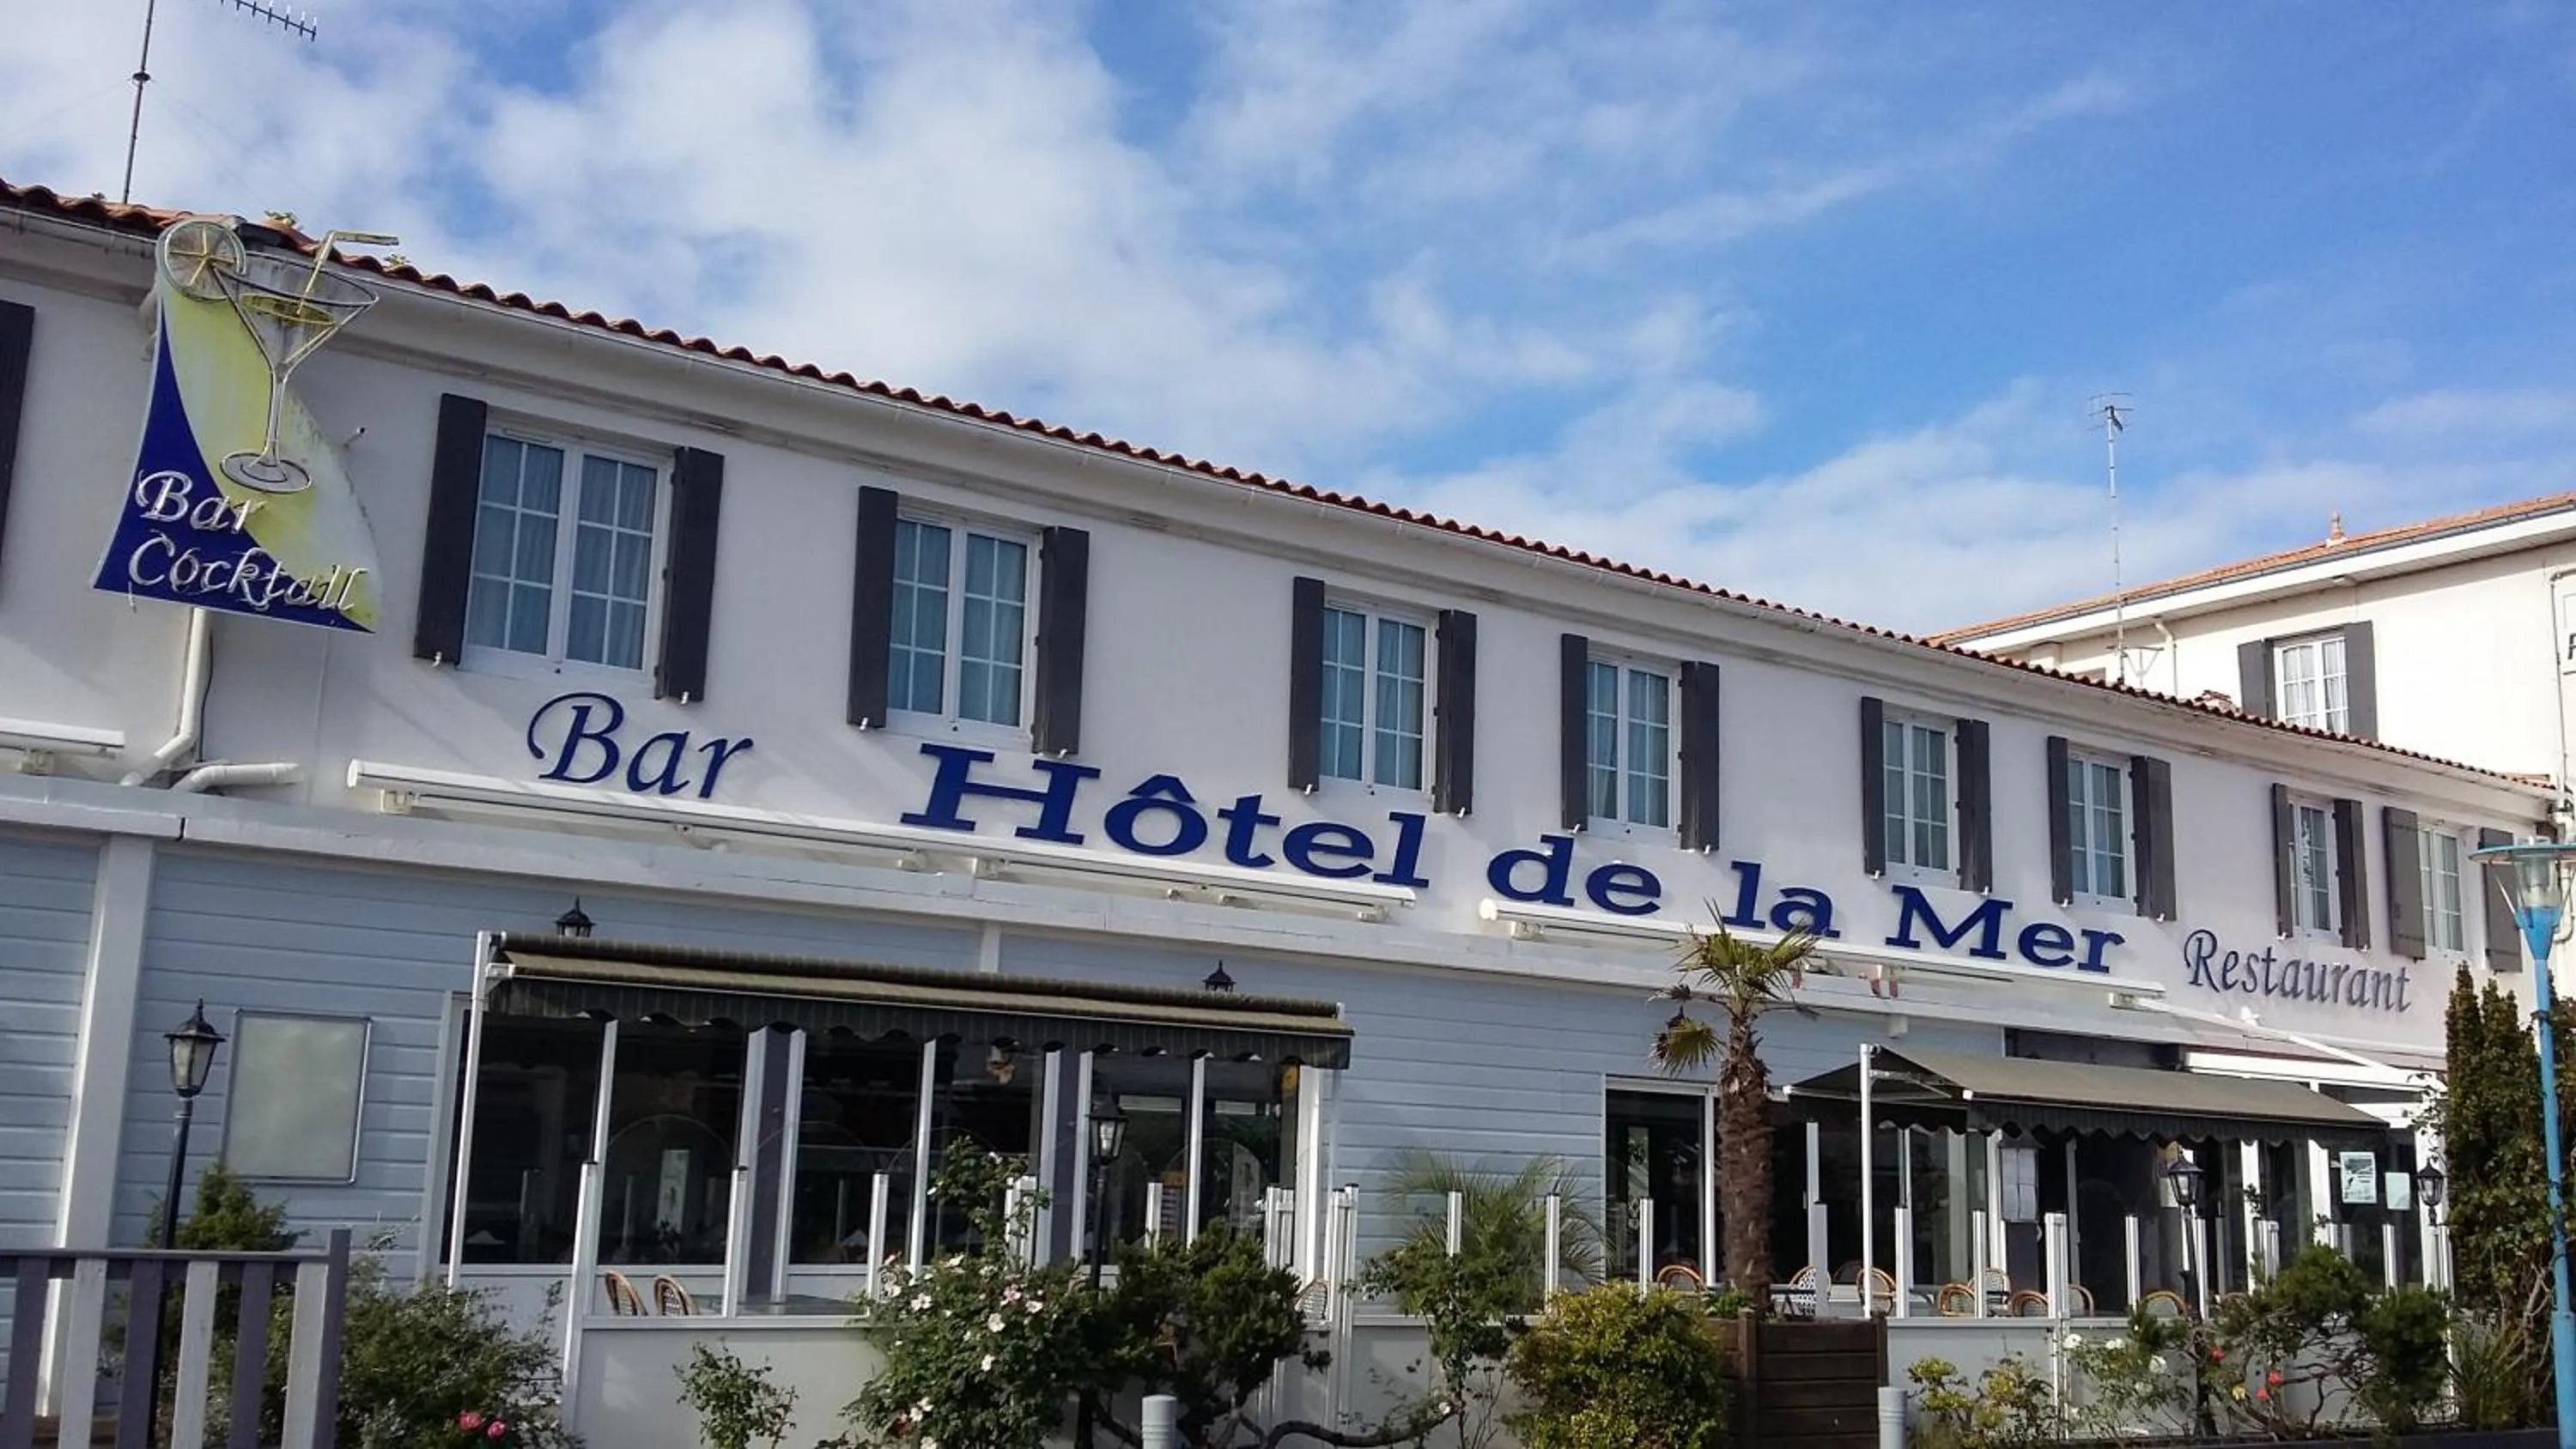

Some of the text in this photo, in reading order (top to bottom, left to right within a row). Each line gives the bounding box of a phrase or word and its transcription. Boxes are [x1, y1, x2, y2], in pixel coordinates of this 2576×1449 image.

[134, 470, 268, 534] Bar
[128, 529, 368, 612] Cocktail
[526, 691, 754, 799] Bar
[899, 743, 2126, 974] Hôtel de la Mer
[2183, 928, 2412, 1013] Restaurant
